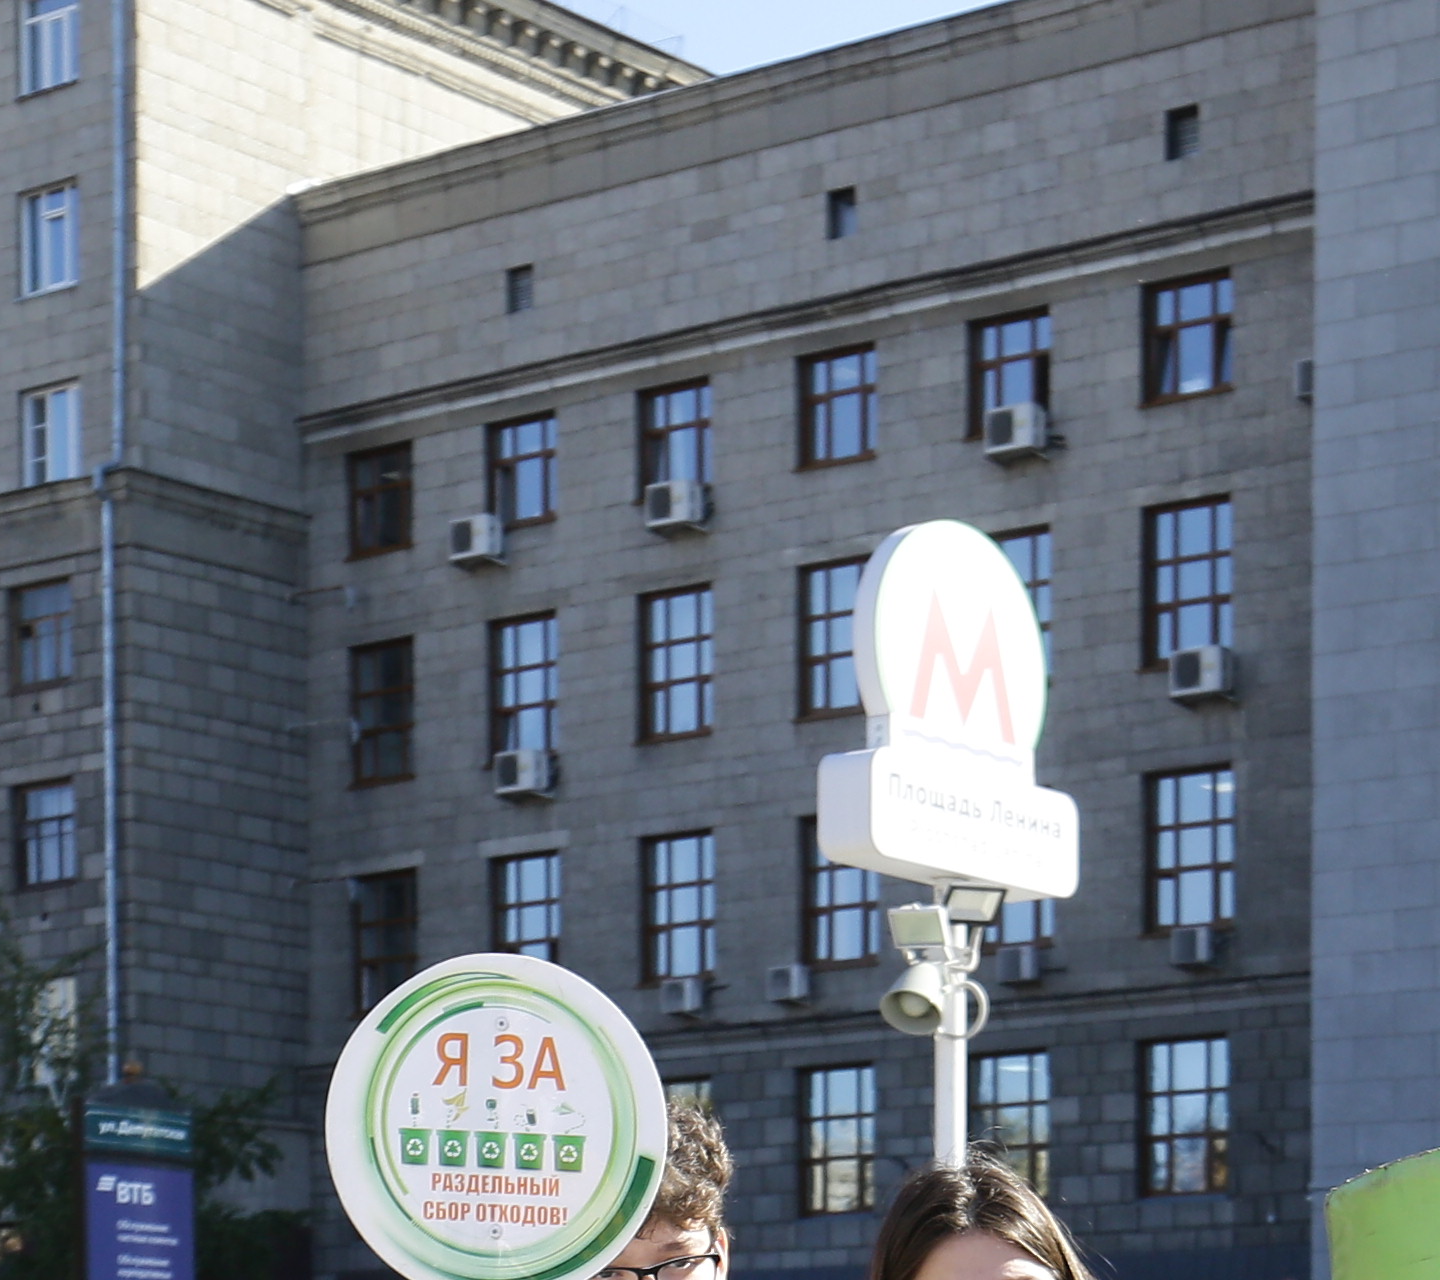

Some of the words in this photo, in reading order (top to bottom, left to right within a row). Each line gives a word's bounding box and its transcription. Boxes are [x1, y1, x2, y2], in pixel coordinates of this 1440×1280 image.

[888, 772, 982, 819] Площадь
[990, 799, 1062, 839] Ленина
[432, 1032, 469, 1086] Я
[491, 1034, 566, 1091] ЗА
[116, 1181, 155, 1206] ВТБ
[431, 1173, 560, 1197] РАЗДЕЛЬНЫЙ
[423, 1203, 471, 1223] СБОР
[475, 1205, 569, 1227] ОТХОДОВ!
